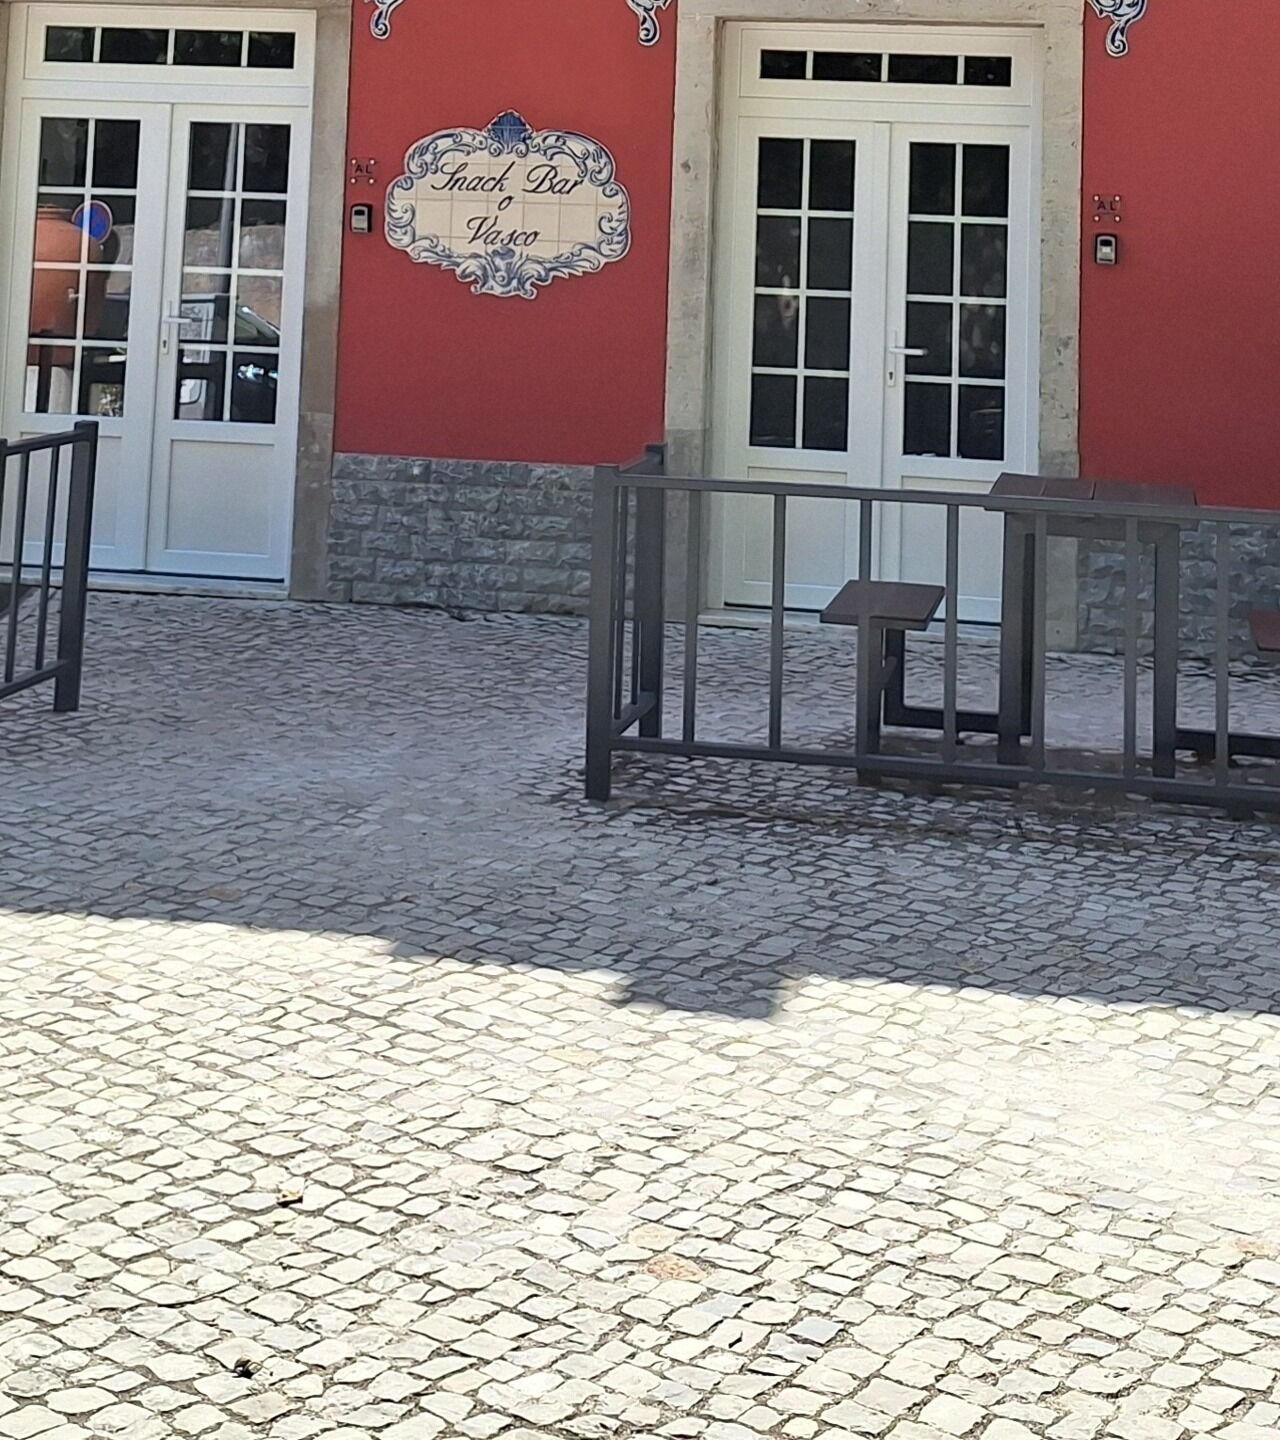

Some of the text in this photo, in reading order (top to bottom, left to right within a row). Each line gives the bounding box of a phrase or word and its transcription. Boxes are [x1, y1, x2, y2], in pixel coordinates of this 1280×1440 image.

[430, 160, 585, 196] Snack Bar
[466, 215, 542, 247] Vasco
